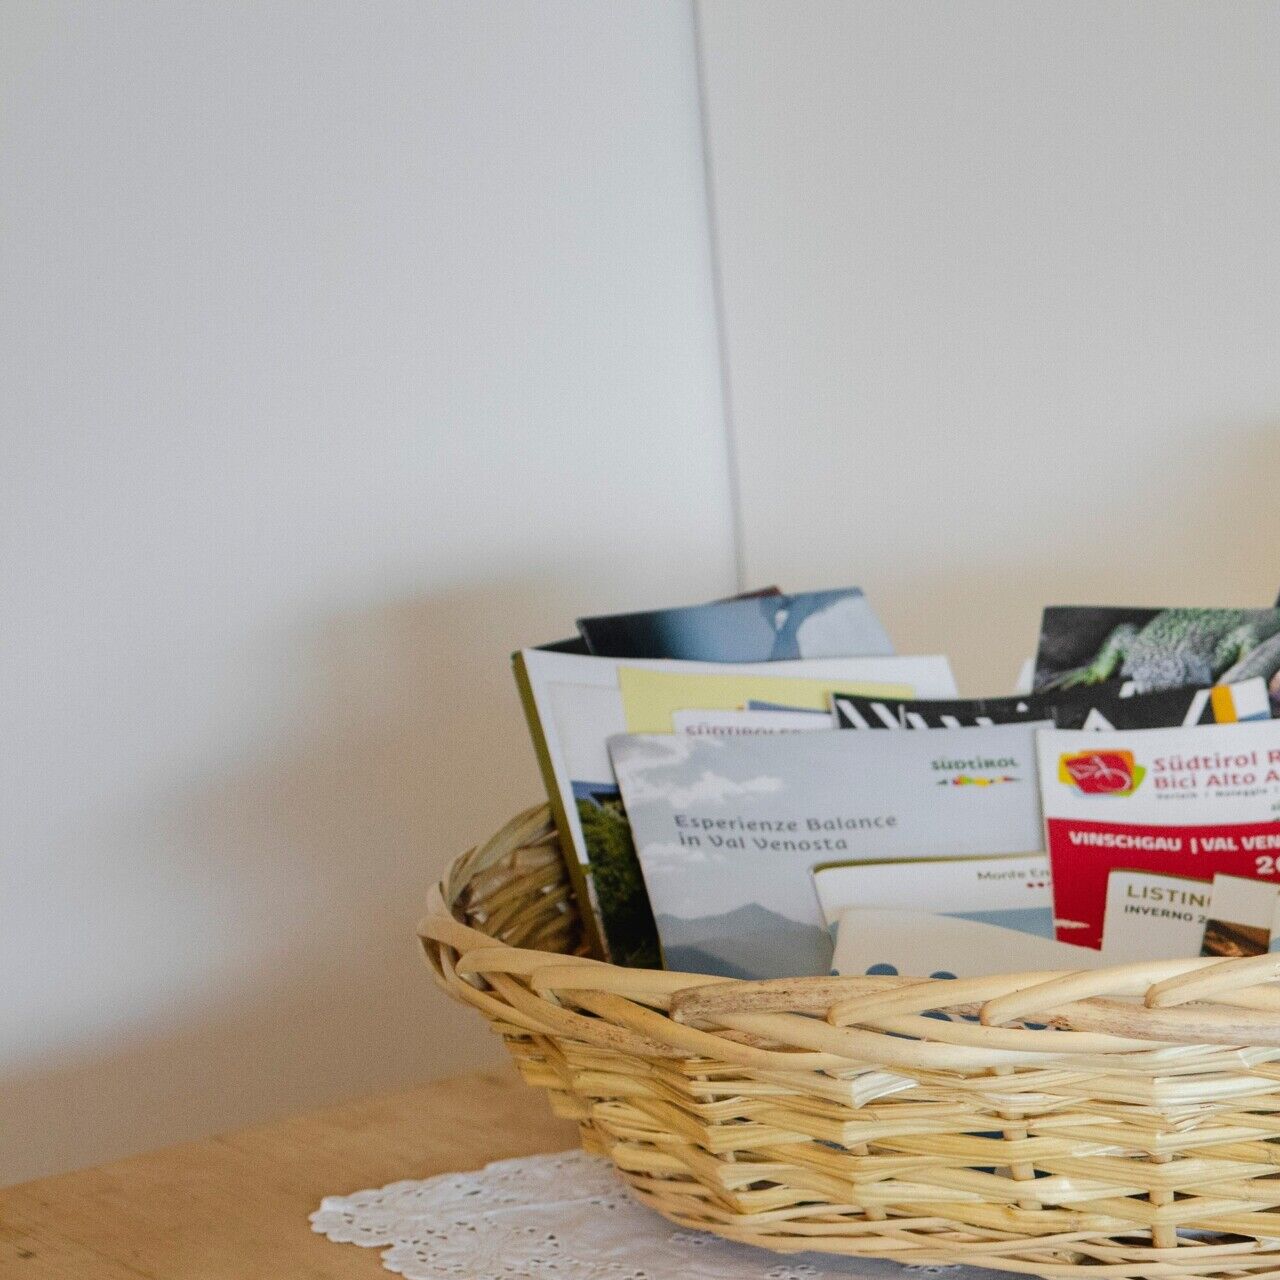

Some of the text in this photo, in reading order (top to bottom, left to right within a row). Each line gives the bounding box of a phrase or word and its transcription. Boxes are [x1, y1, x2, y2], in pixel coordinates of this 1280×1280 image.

[1153, 752, 1258, 773] Südtirol
[1153, 775, 1197, 790] Bici
[1207, 773, 1257, 787] Alto
[674, 814, 898, 832] Esperienze Balance
[680, 830, 848, 851] in Val Venosta
[1068, 831, 1182, 852] VINSCHGAU
[1200, 836, 1239, 852] VAL
[1124, 904, 1193, 921] INVERNO
